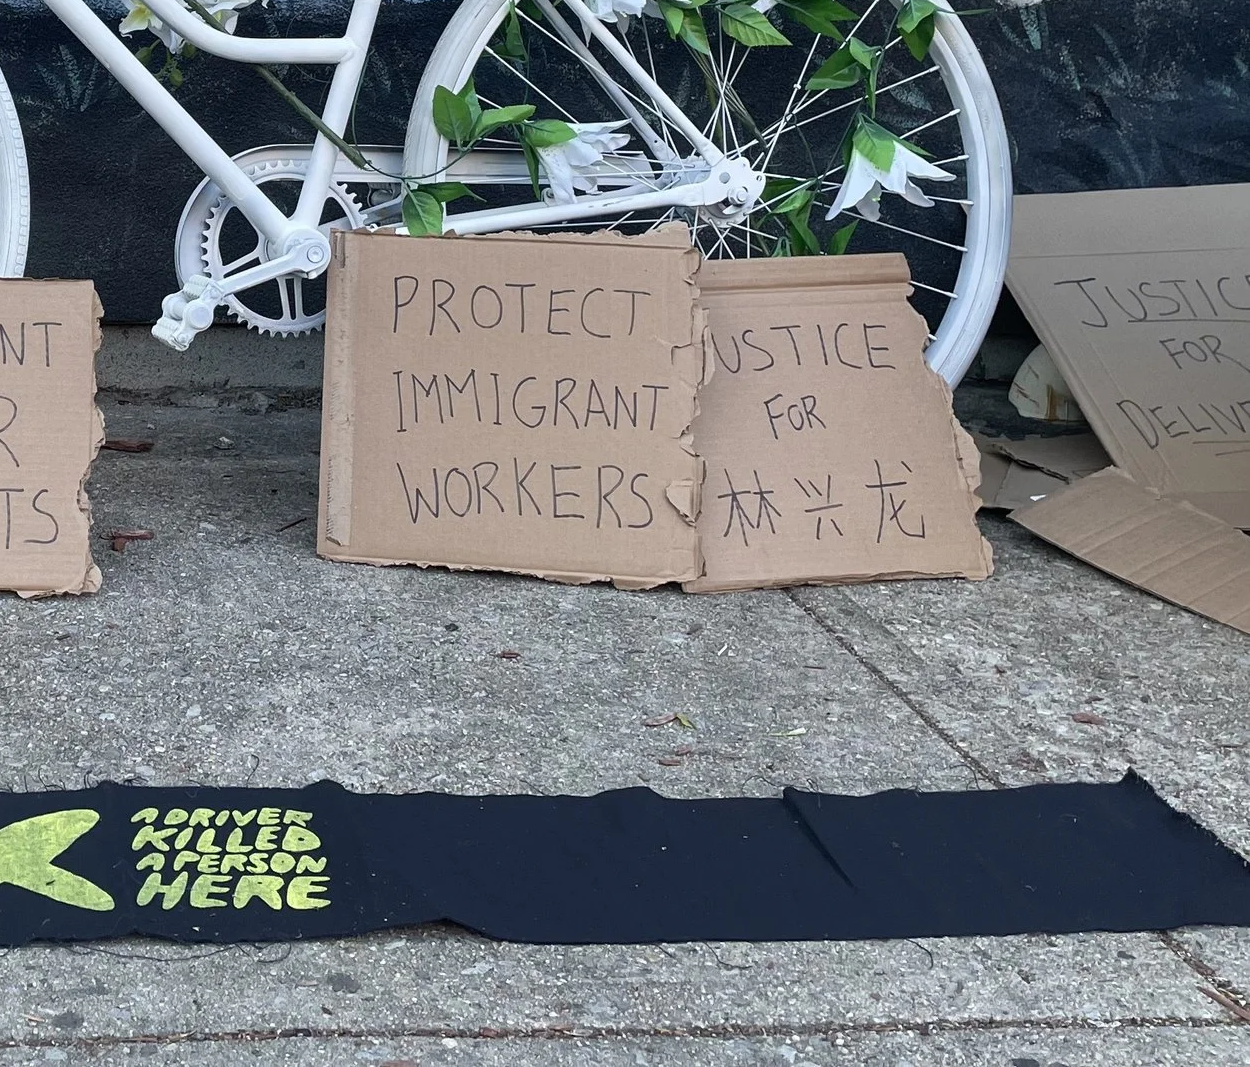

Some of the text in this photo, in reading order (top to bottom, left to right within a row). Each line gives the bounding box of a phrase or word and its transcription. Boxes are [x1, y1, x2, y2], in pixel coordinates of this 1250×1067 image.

[392, 275, 652, 339] PROTECT
[1054, 274, 1250, 328] JUSTIC
[710, 323, 897, 374] USTICE
[1159, 334, 1250, 374] FOR
[392, 369, 670, 433] IMMIGRANT
[764, 394, 827, 440] FOR
[396, 457, 654, 529] WORKERS
[717, 459, 926, 547] 林兴龙
[130, 807, 314, 828] A DRIVER
[131, 825, 322, 854] KILLED
[136, 850, 328, 875] A PERSON
[136, 871, 332, 911] HERE
